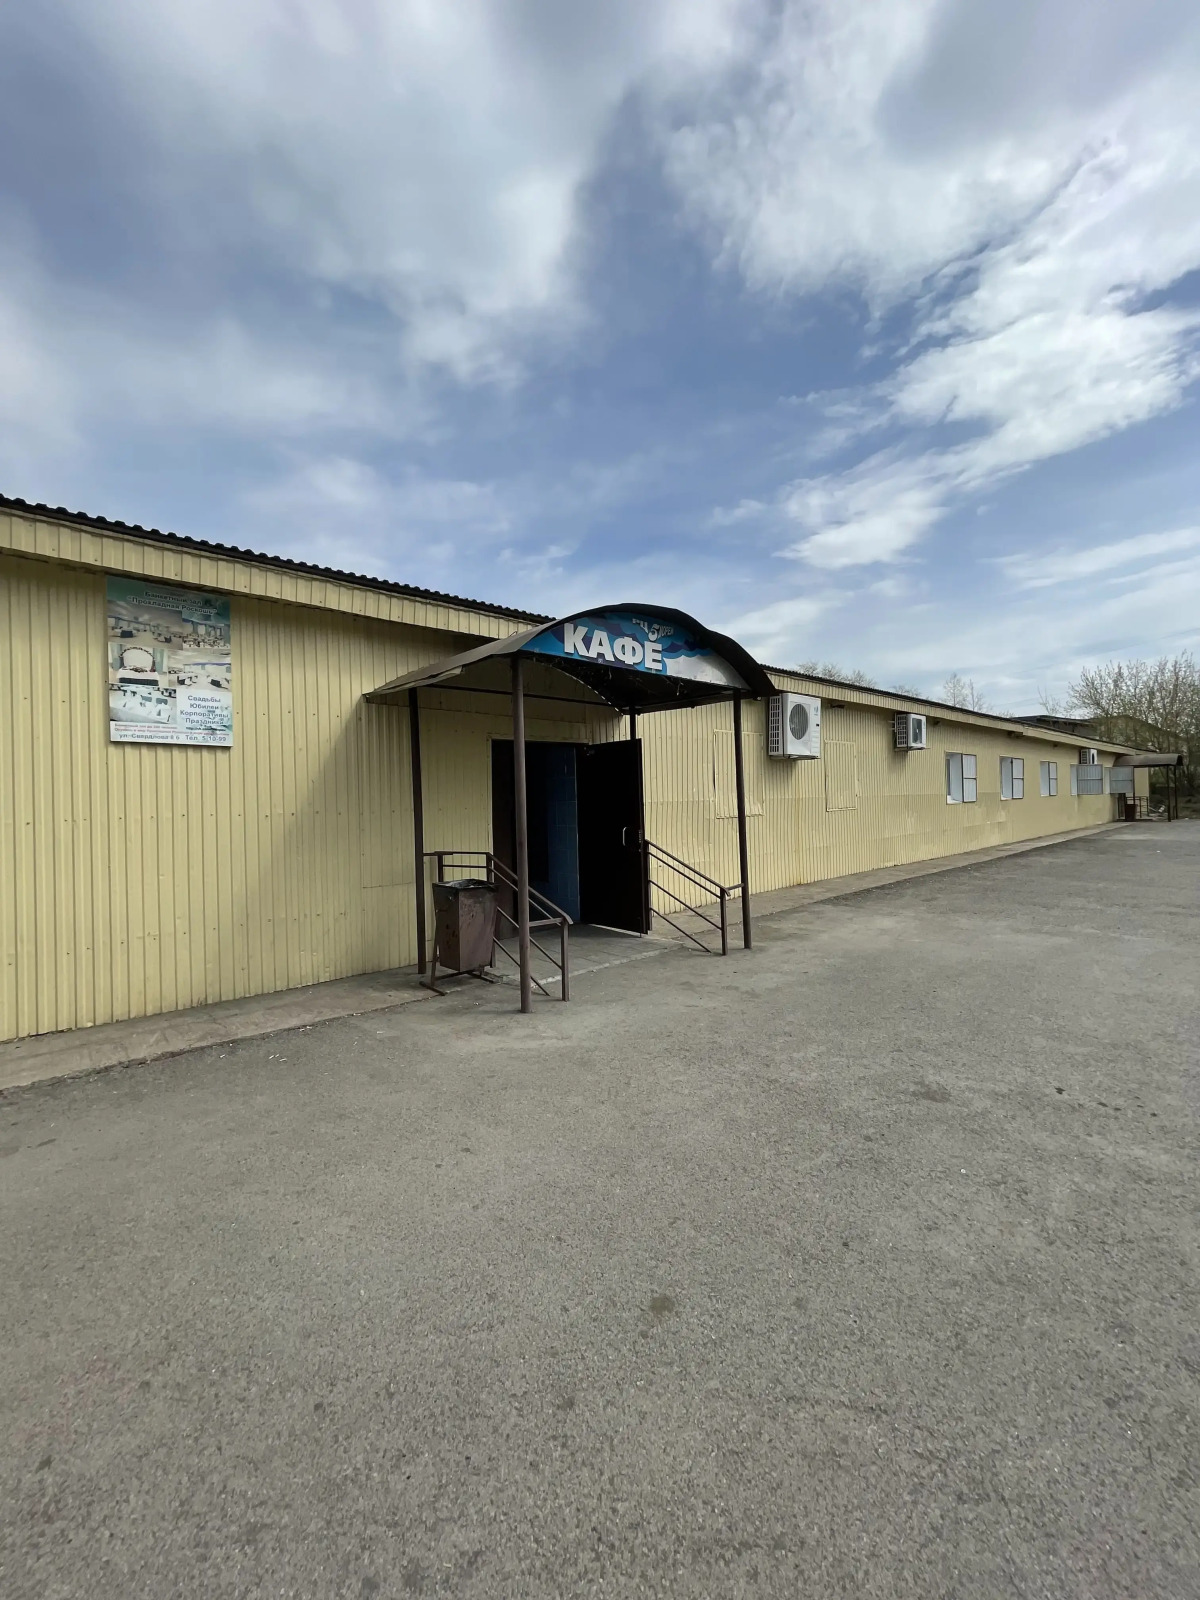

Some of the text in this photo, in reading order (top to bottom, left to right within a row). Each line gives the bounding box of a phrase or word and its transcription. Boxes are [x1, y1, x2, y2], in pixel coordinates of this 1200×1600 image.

[563, 622, 663, 671] КАФЕ
[187, 695, 221, 703] Свадьбы
[180, 709, 229, 718] Корпоративы
[185, 717, 224, 725] Праздники
